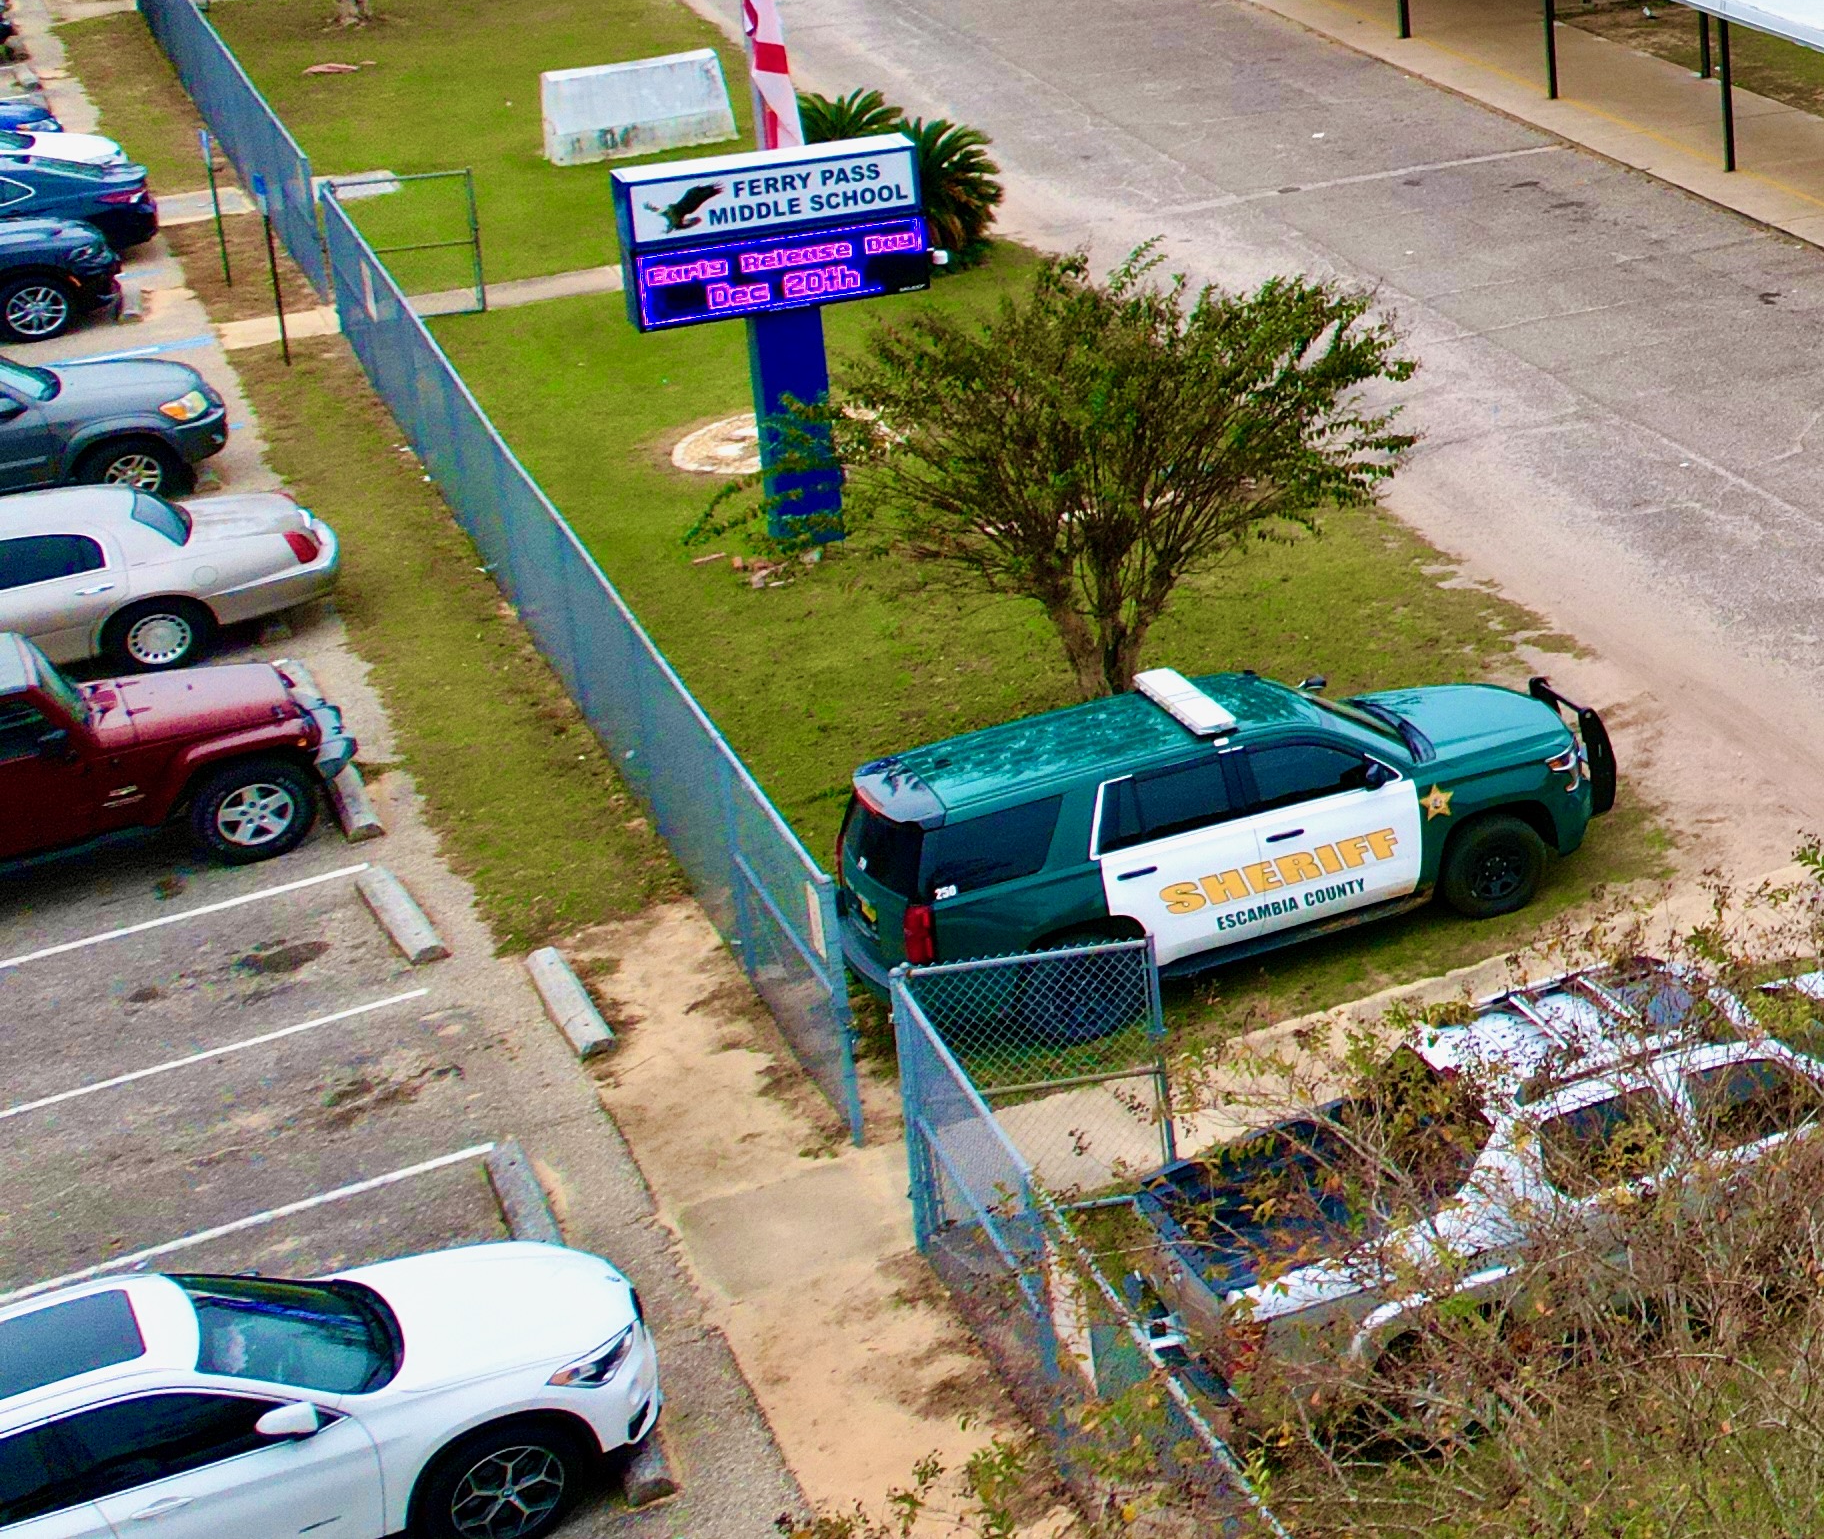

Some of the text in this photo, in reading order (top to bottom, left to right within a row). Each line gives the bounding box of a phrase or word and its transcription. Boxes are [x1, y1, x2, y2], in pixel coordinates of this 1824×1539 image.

[733, 163, 880, 198] FERRY PASS
[709, 184, 908, 226] MIDDLE SCHOOL
[646, 232, 915, 286] Early Release Day
[706, 265, 860, 309] Dec 20th
[934, 884, 957, 900] 250
[1159, 827, 1398, 915] SHERIFF
[1216, 877, 1365, 931] ESCAMBIA COUNTY
